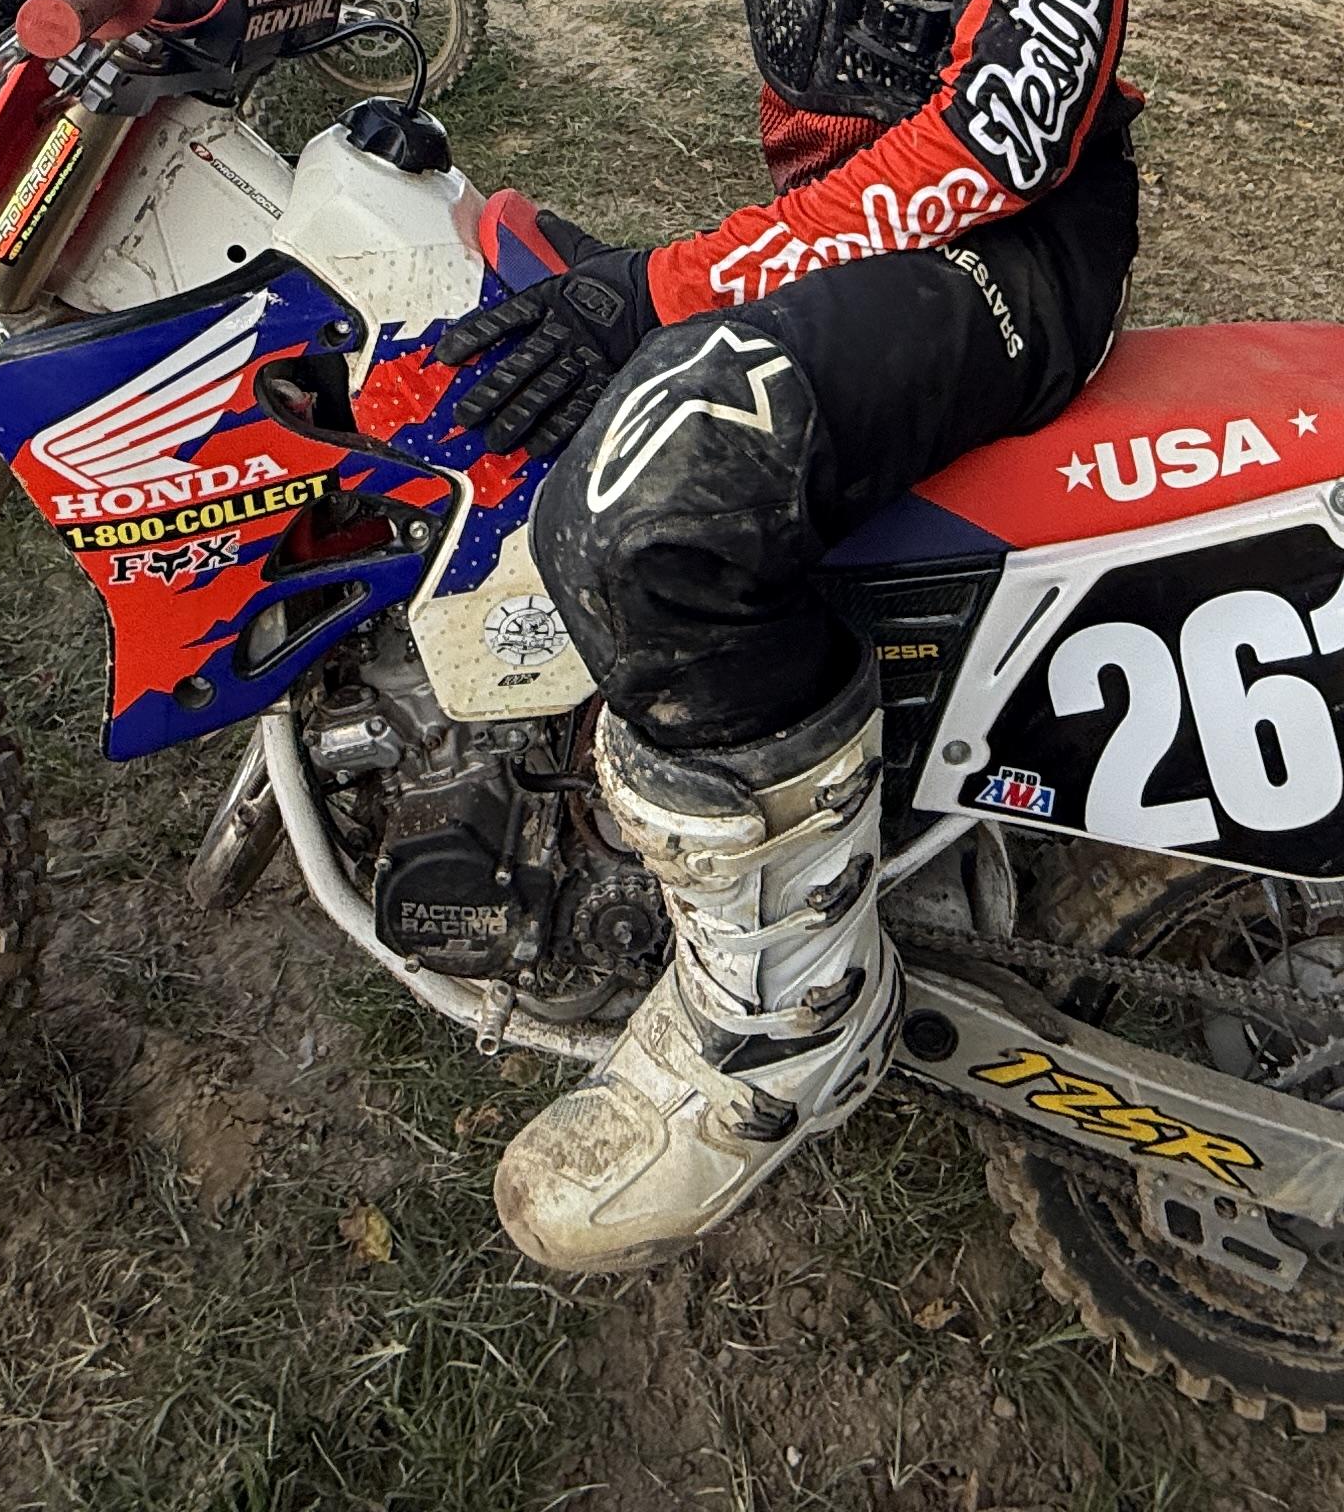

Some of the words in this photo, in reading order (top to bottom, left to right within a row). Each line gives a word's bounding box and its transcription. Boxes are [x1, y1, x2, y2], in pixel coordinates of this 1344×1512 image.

[17, 122, 74, 208] CIRCUIT
[250, 192, 284, 220] JOCKE
[935, 242, 1025, 359] NESTARS
[1093, 418, 1281, 501] USA
[51, 454, 289, 521] HONDA
[66, 475, 329, 550] 1-800-COLLECT
[980, 778, 1052, 814] AMA
[1001, 769, 1038, 787] PRO
[400, 901, 509, 921] FACTORY
[400, 917, 508, 940] RACING
